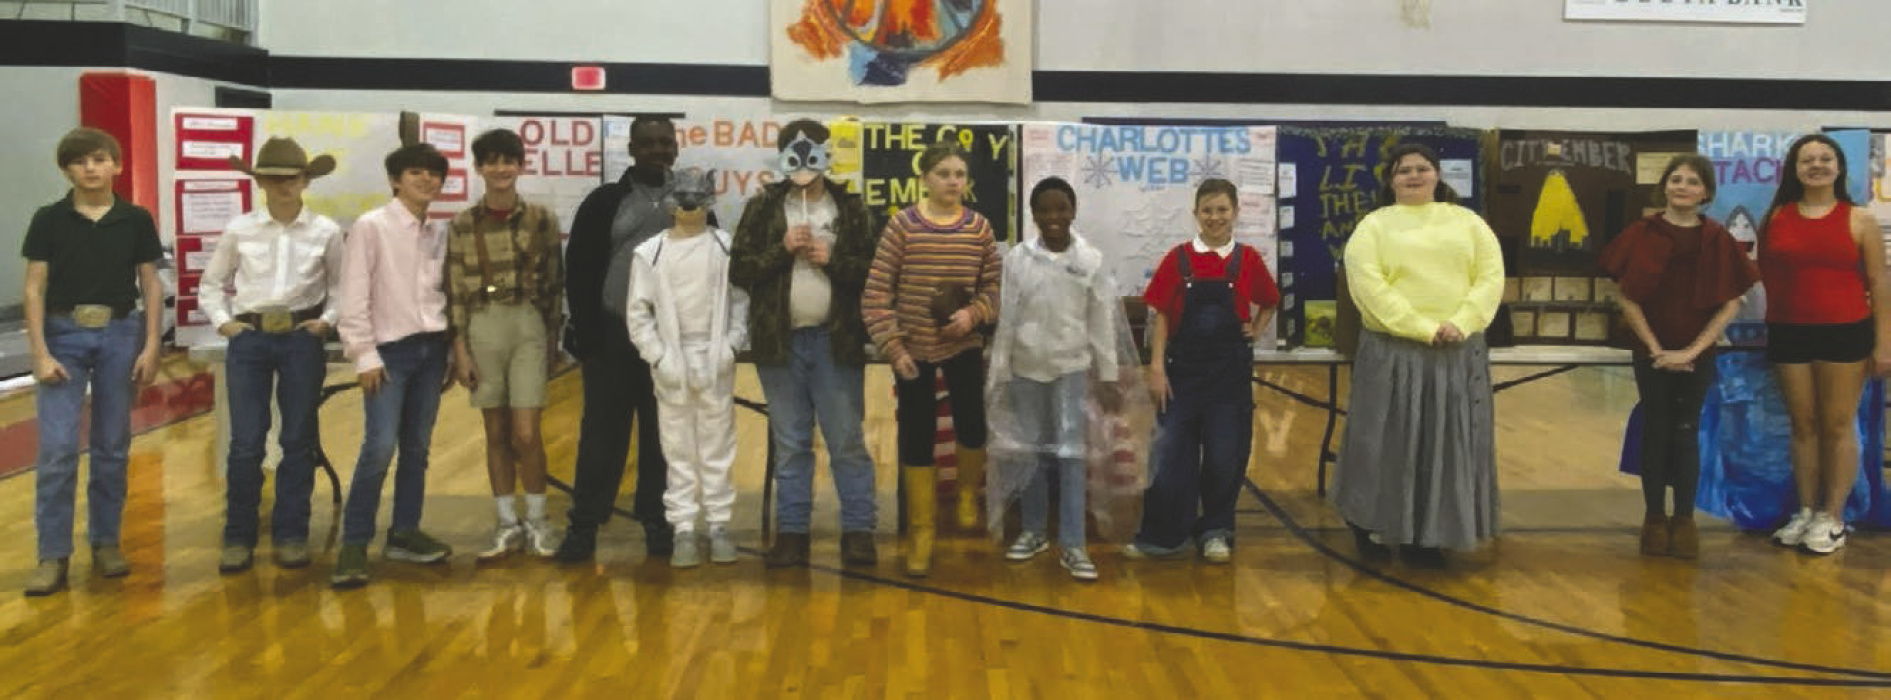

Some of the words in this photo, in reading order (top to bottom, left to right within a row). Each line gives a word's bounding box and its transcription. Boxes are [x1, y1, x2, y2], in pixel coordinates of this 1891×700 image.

[520, 119, 594, 145] OLD
[865, 124, 926, 149] THE
[1057, 125, 1252, 154] CHARLOTTES
[1117, 156, 1190, 184] WEB
